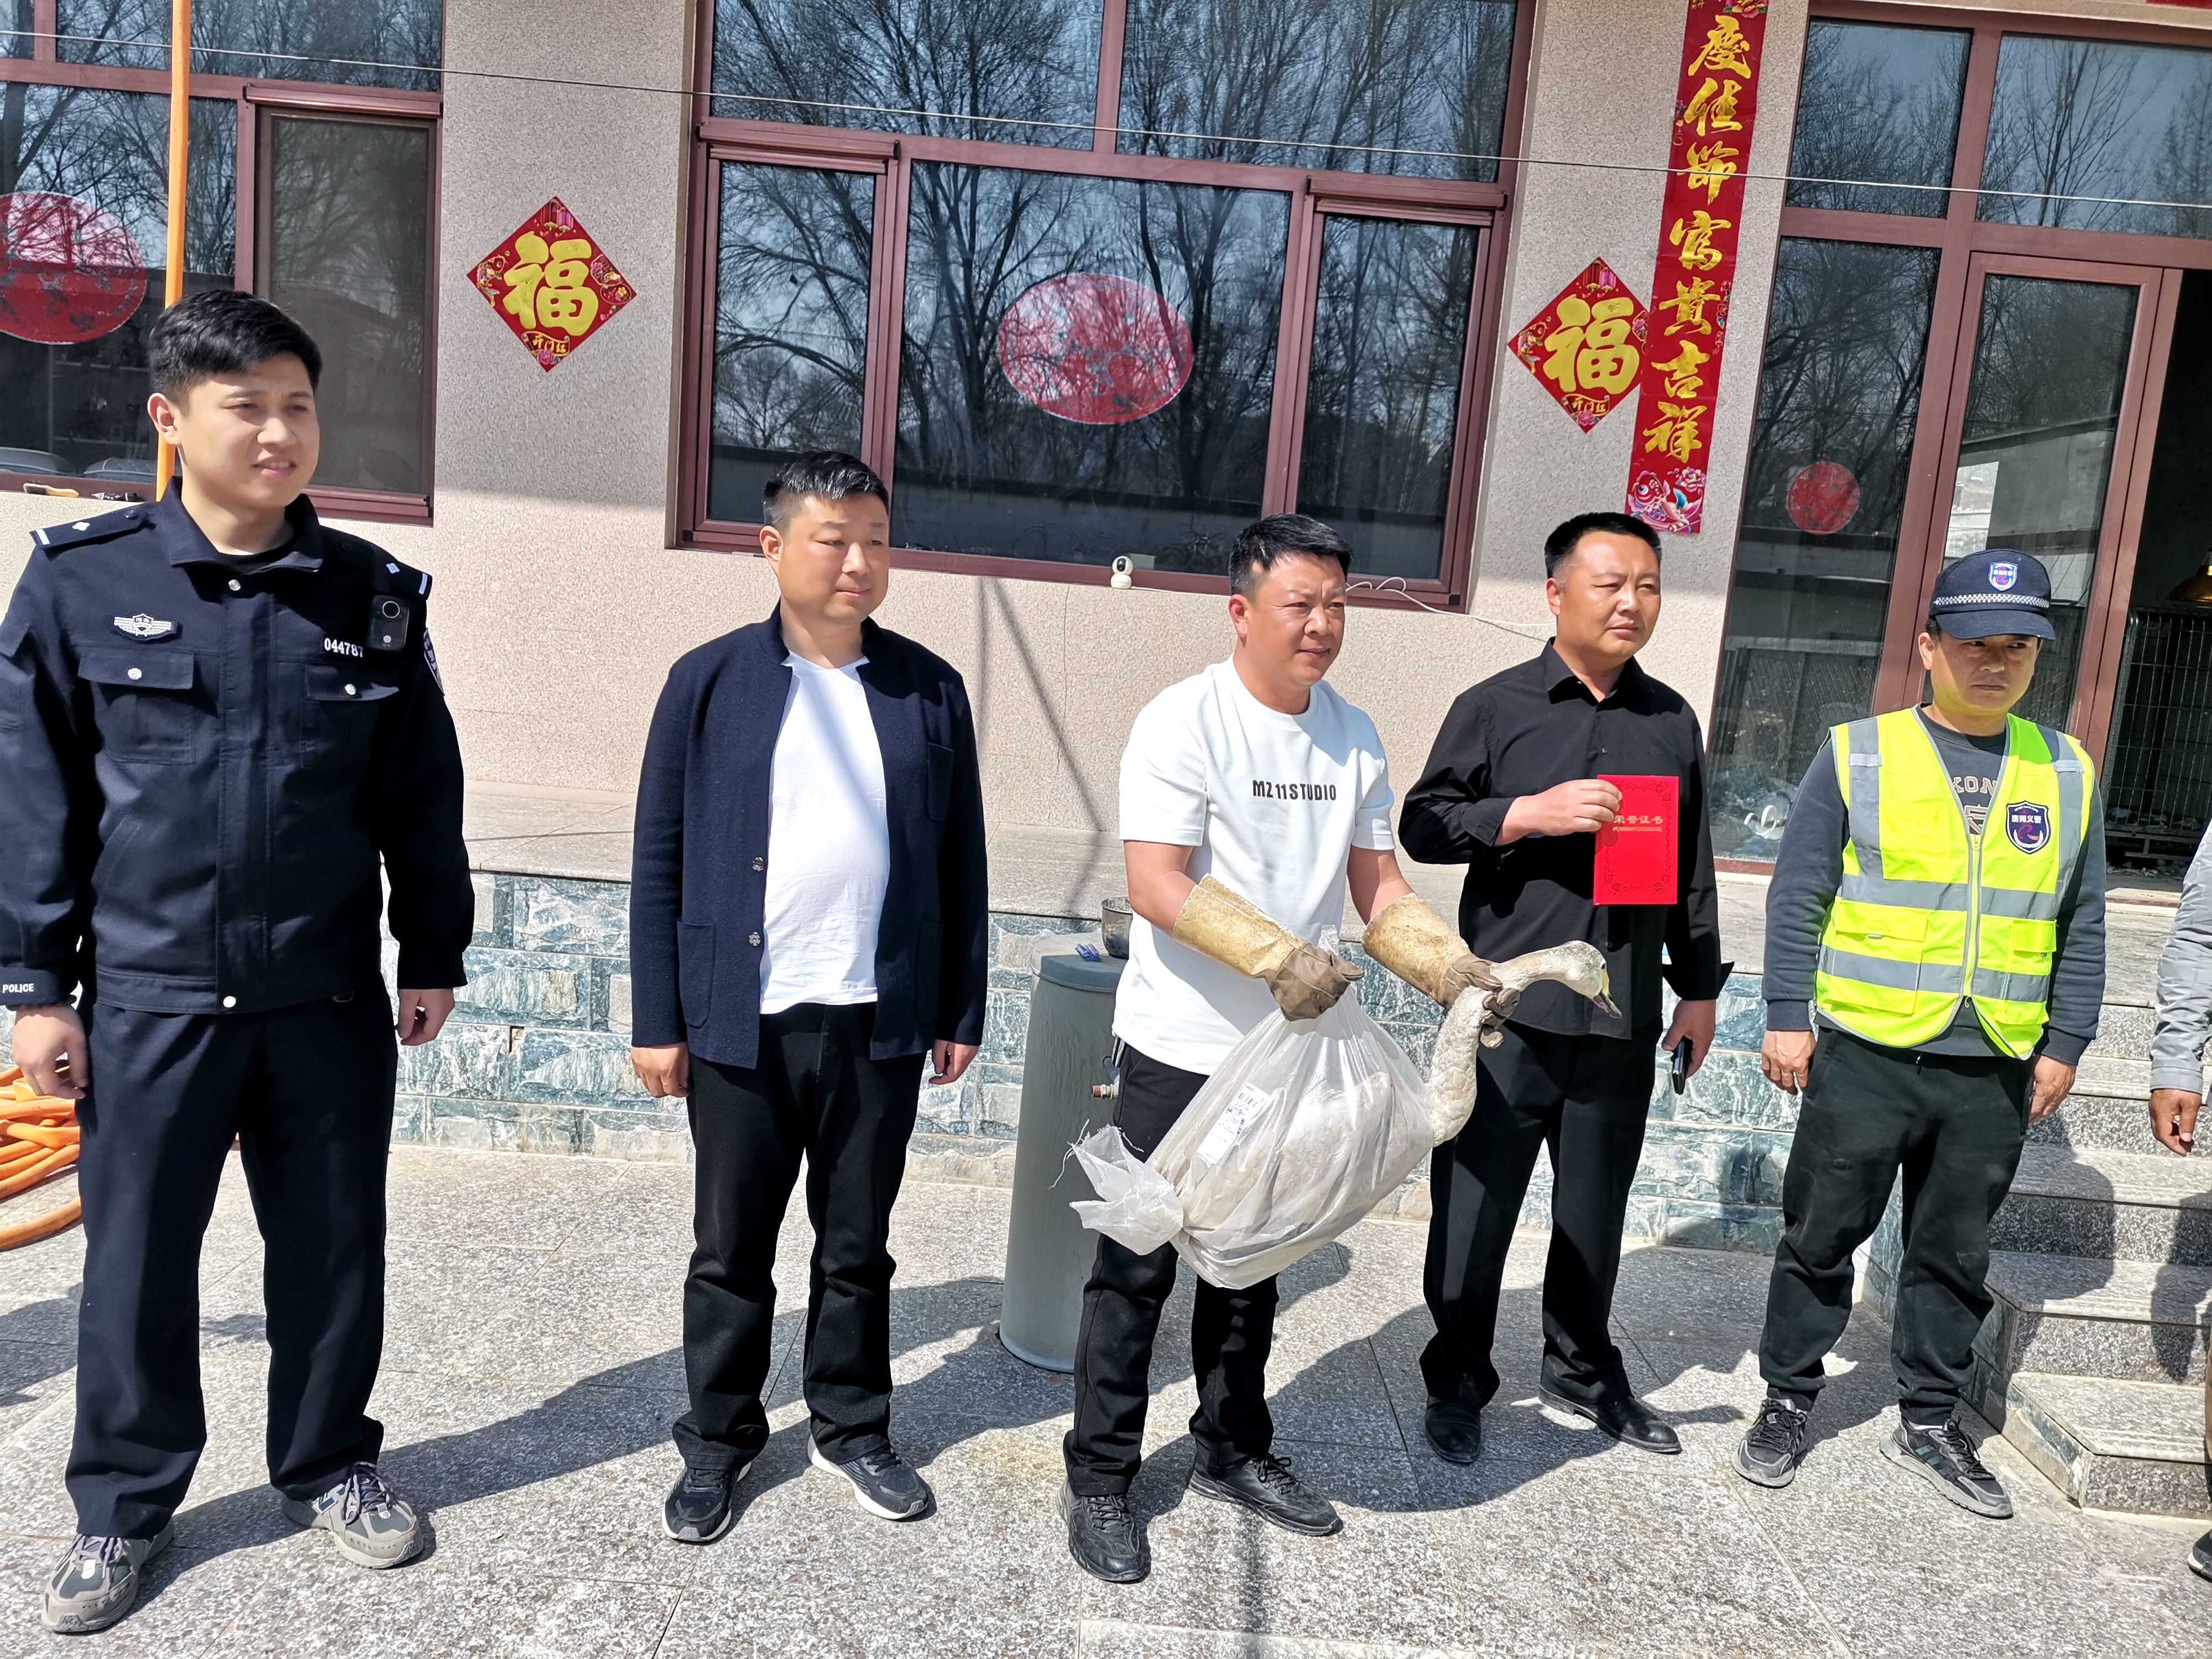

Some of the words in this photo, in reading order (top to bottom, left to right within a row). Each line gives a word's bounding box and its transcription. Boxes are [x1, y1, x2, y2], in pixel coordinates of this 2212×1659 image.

[503, 231, 598, 336] 福
[532, 334, 566, 353] 开门红
[1543, 295, 1640, 394] 福
[1572, 397, 1606, 413] 开门红
[324, 638, 363, 658] 044787
[2, 983, 34, 994] POLICE
